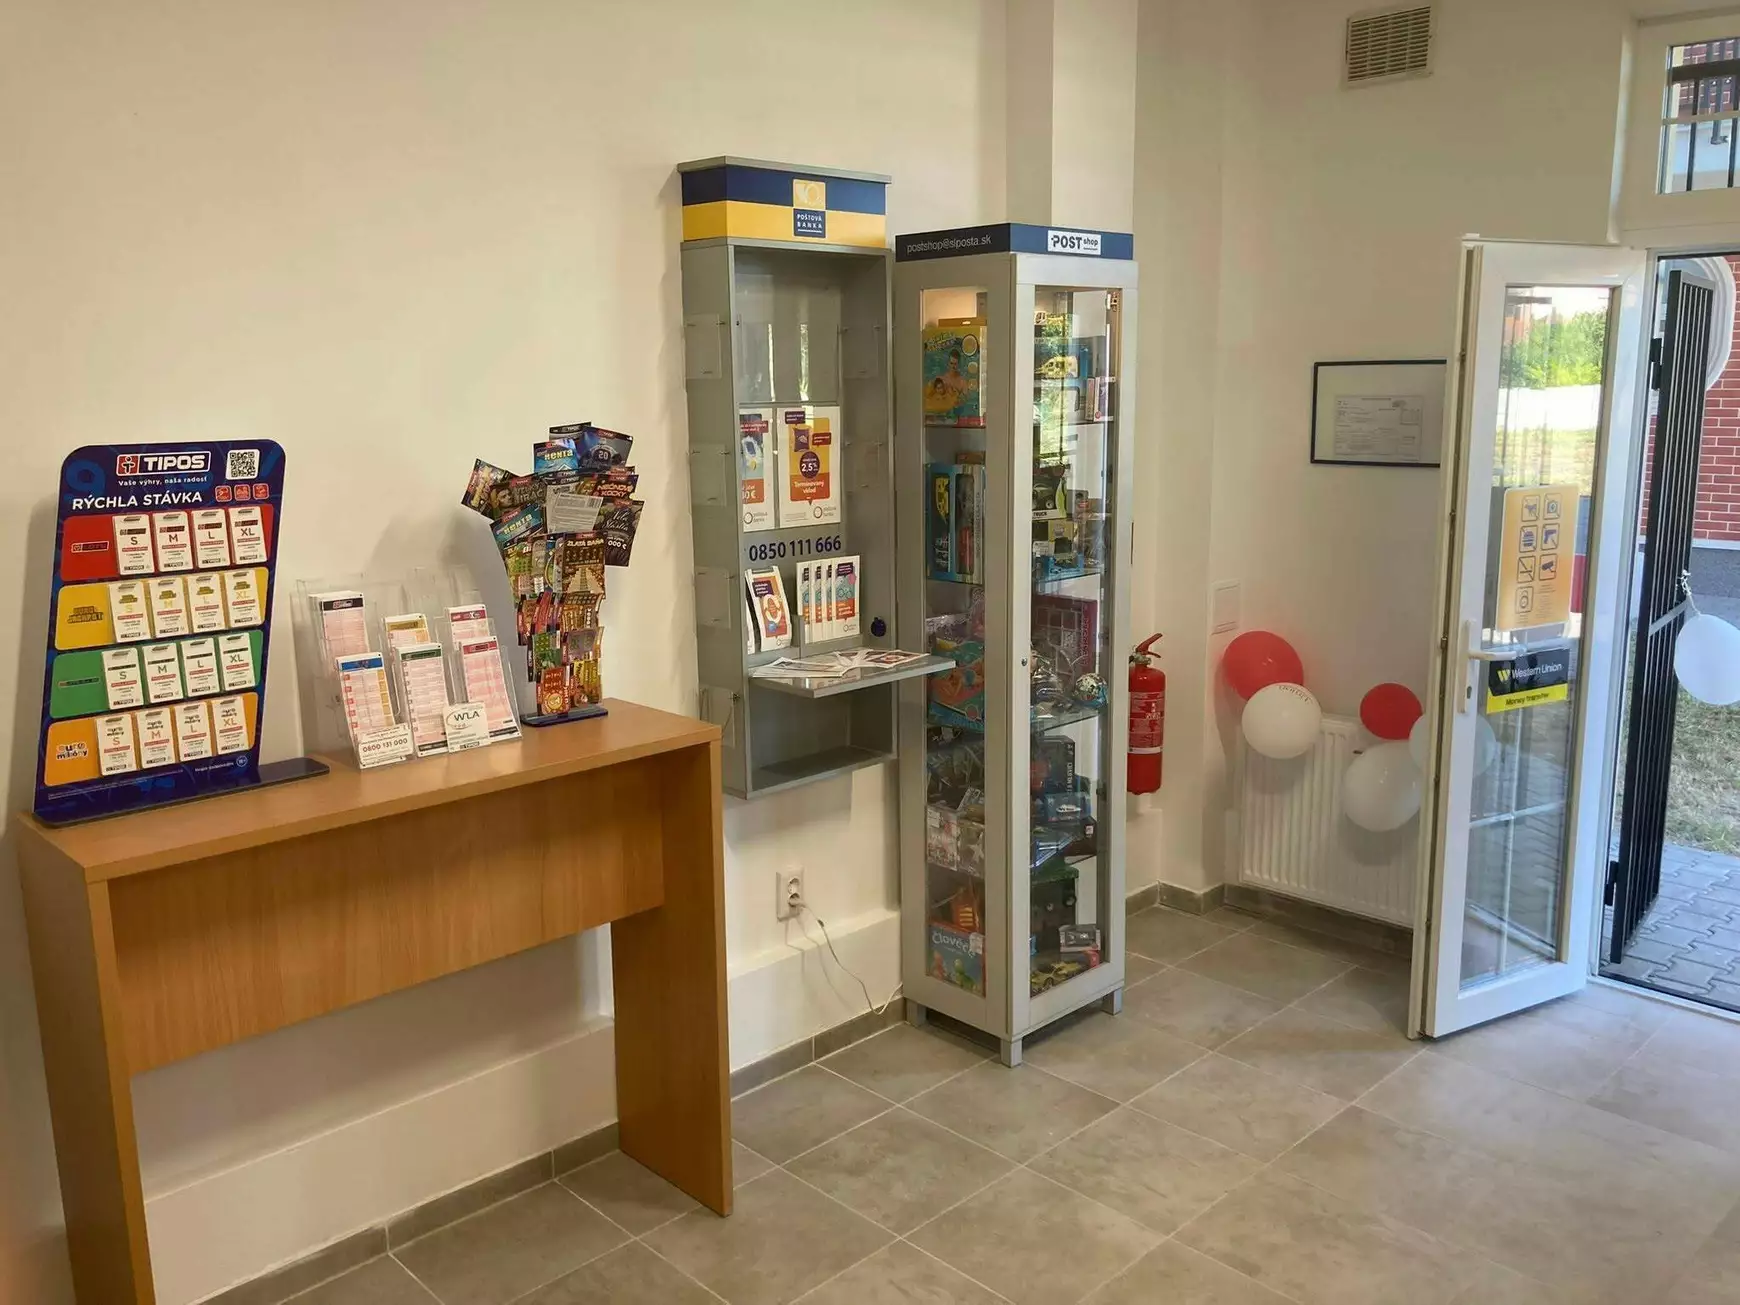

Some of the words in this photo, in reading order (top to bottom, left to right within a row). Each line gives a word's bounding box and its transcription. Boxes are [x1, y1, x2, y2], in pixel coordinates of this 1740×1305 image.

[796, 213, 822, 222] POŠTOVÁ
[796, 221, 823, 229] BANKA
[906, 234, 993, 255] postshop@slposta.sk
[1051, 234, 1083, 250] POST
[1083, 237, 1099, 247] shop
[143, 454, 206, 471] TIPOS
[72, 494, 138, 511] RÝCHLA
[142, 490, 203, 506] STÁVKA
[130, 536, 138, 546] S
[168, 533, 179, 543] M
[208, 531, 215, 540] L
[240, 527, 255, 537] XL
[749, 541, 786, 561] 0850
[789, 538, 811, 557] 111
[815, 535, 842, 553] 666
[125, 604, 133, 613] S
[164, 599, 173, 608] M
[204, 595, 210, 604] L
[236, 590, 250, 599] XL
[119, 672, 127, 680] S
[158, 664, 167, 674] M
[197, 660, 203, 669] L
[230, 654, 244, 663] XL
[1512, 666, 1541, 679] Western
[1541, 662, 1562, 674] Union
[453, 710, 480, 721] WLA
[113, 737, 121, 746] S
[152, 730, 161, 739] M
[190, 725, 198, 734] L
[223, 717, 237, 727] XL
